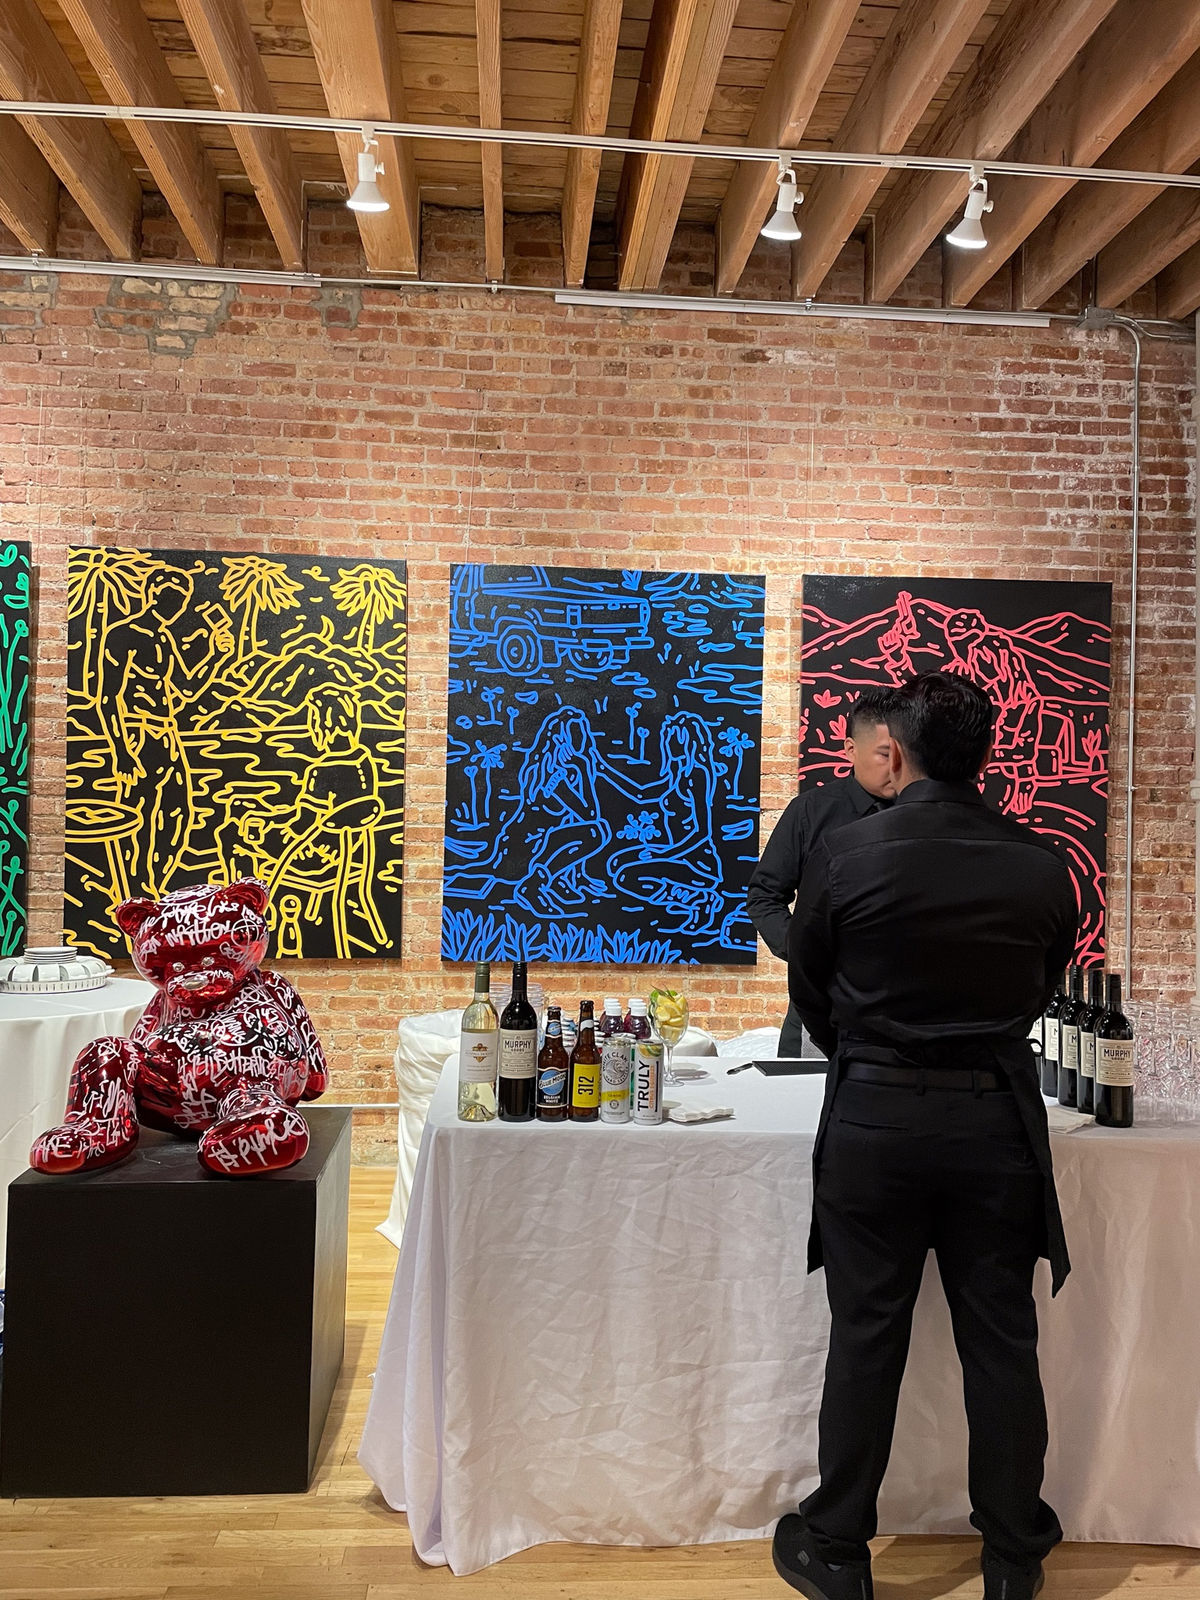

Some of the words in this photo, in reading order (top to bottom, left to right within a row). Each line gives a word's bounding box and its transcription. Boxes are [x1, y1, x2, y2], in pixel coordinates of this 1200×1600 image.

[504, 1040, 532, 1049] MURPHY
[1103, 1049, 1131, 1058] MURPHY
[602, 1052, 611, 1072] WHITE
[611, 1051, 628, 1063] CLAW
[577, 1076, 594, 1095] 312
[637, 1060, 650, 1111] TRULY
